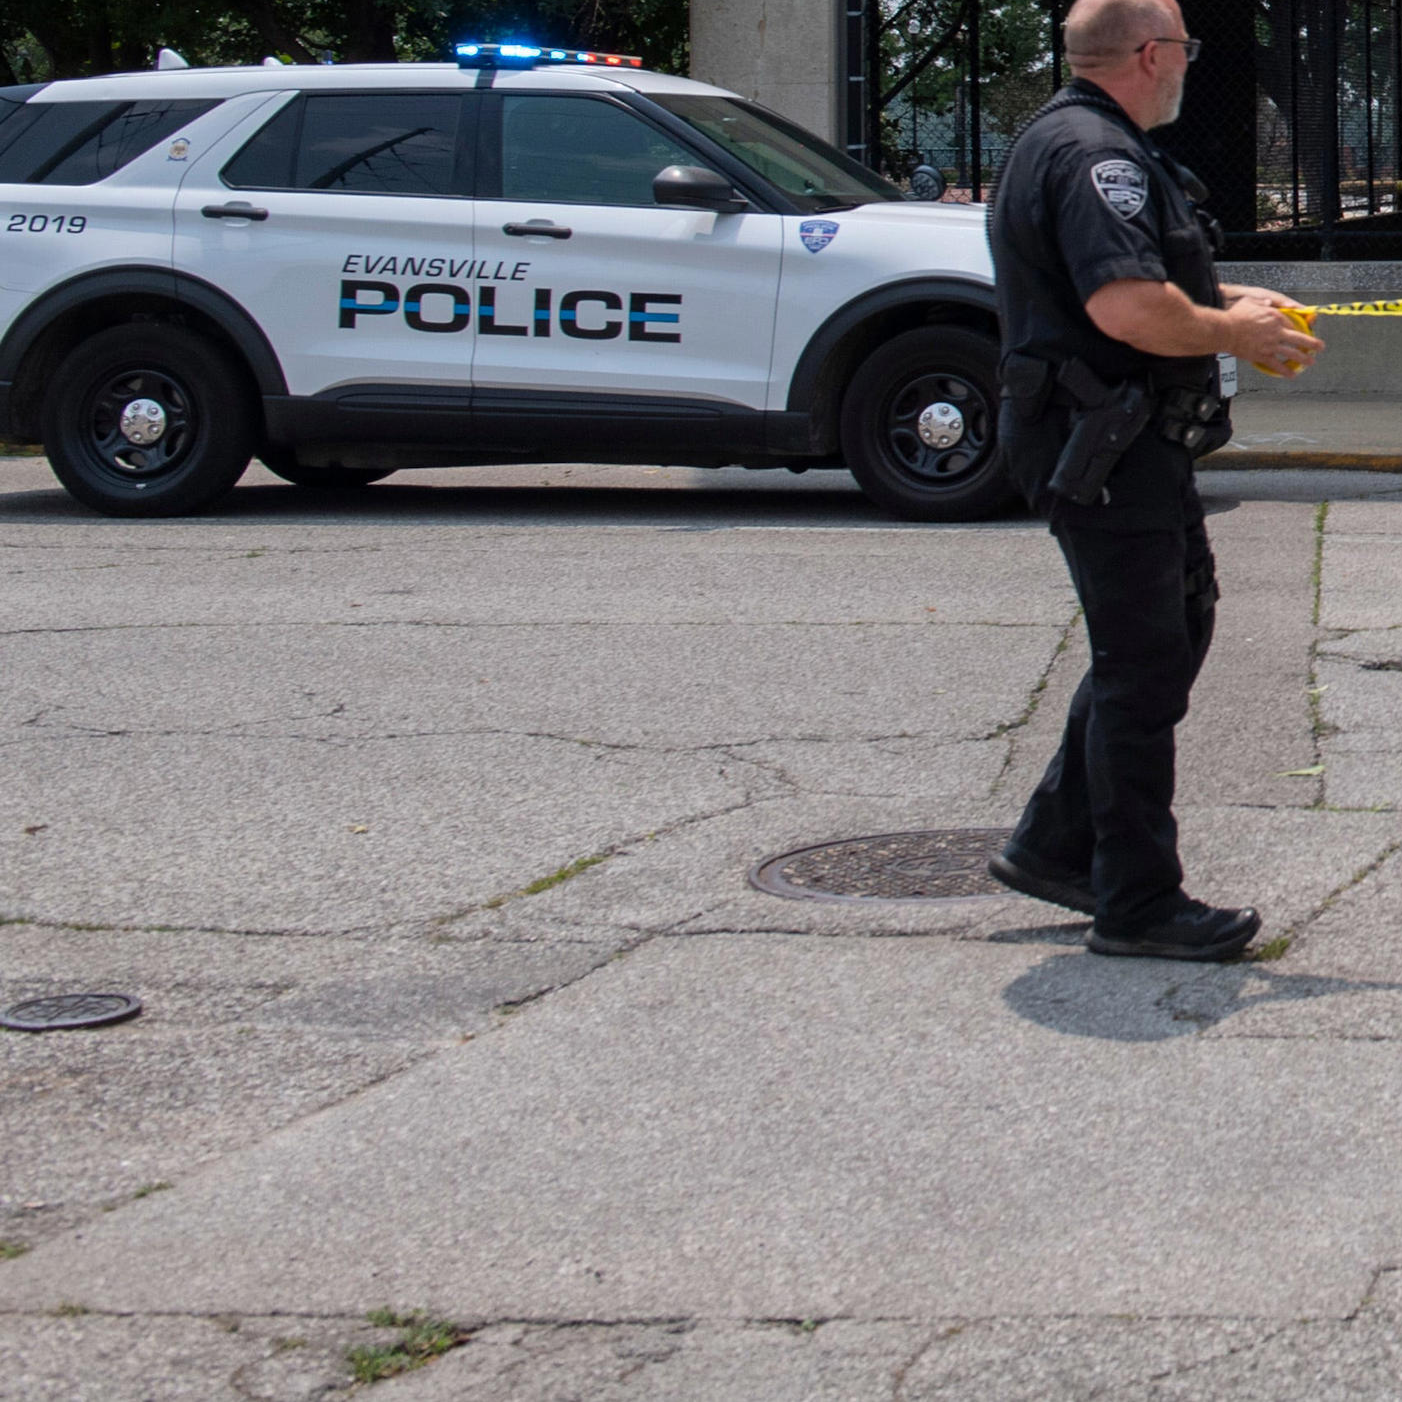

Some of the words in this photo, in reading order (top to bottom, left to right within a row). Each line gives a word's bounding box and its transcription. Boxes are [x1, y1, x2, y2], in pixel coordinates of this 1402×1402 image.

[7, 214, 87, 234] 2019
[342, 254, 531, 281] EVANSVILLE
[338, 279, 683, 343] POLICE
